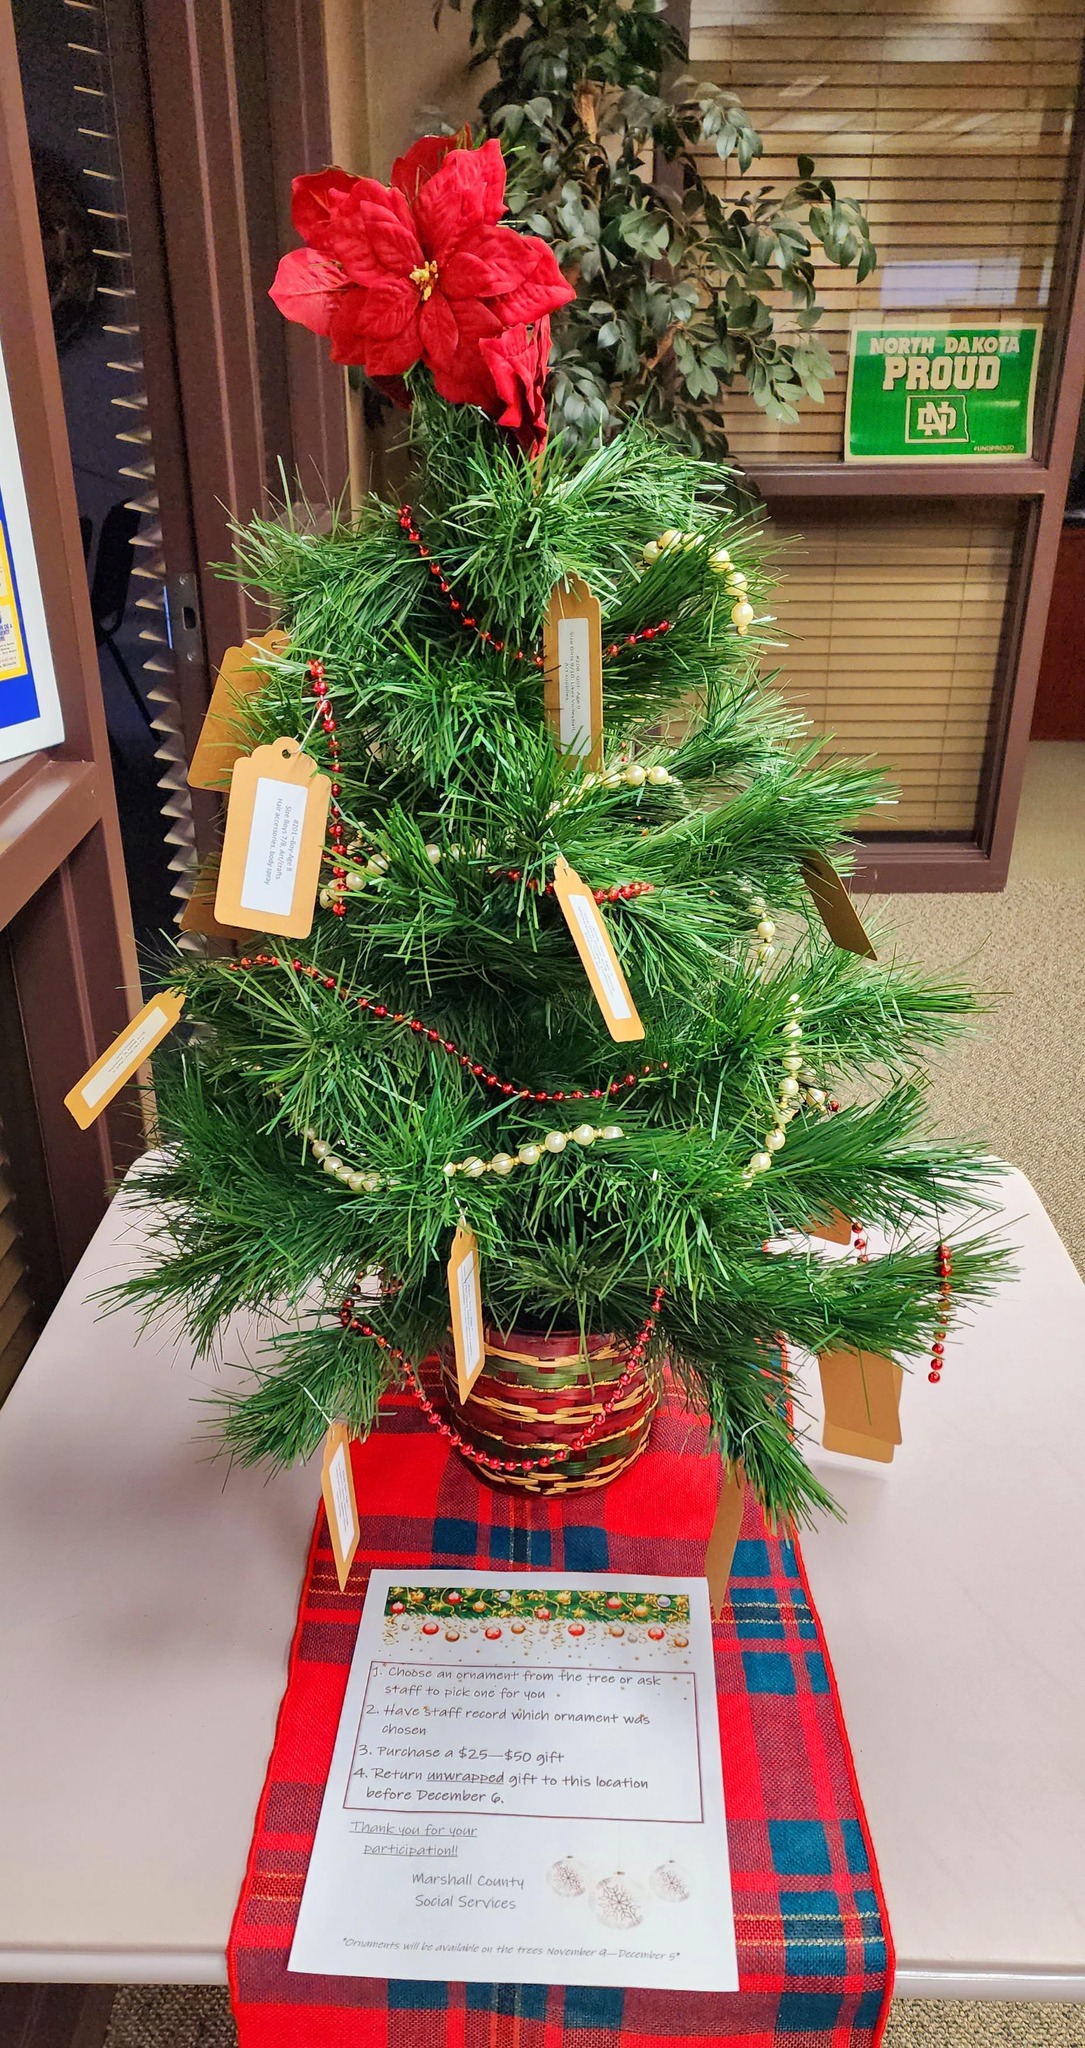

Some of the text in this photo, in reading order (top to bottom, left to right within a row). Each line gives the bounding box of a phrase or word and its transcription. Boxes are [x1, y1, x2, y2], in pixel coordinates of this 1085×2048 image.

[870, 336, 1020, 355] NORTH DAKOTA
[882, 356, 1001, 390] PROUD
[281, 820, 289, 834] Boys
[267, 851, 275, 867] body
[264, 868, 272, 885] spray
[372, 1666, 662, 1686] 1. Choose an ornament from the tree or ask
[384, 1684, 546, 1701] staff to pick one for you
[365, 1704, 650, 1725] 2. Have staff record which ornament was
[381, 1724, 426, 1736] chosen
[358, 1744, 372, 1755] 3.
[377, 1745, 441, 1758] Purchase
[444, 1749, 453, 1758] a
[536, 1751, 565, 1766] gift
[353, 1767, 648, 1789] 4. Return unwrapped gift to this location
[366, 1786, 504, 1804] before December 6.
[350, 1821, 478, 1837] Thank you for your
[363, 1844, 458, 1857] participation!!
[412, 1873, 524, 1890] Marshall County
[415, 1894, 517, 1909] Social Services
[402, 1941, 419, 1951] will
[421, 1942, 433, 1951] be
[435, 1943, 479, 1953] available
[481, 1946, 494, 1954] on
[496, 1945, 514, 1955] the
[517, 1947, 544, 1955] trees
[546, 1947, 597, 1956] November
